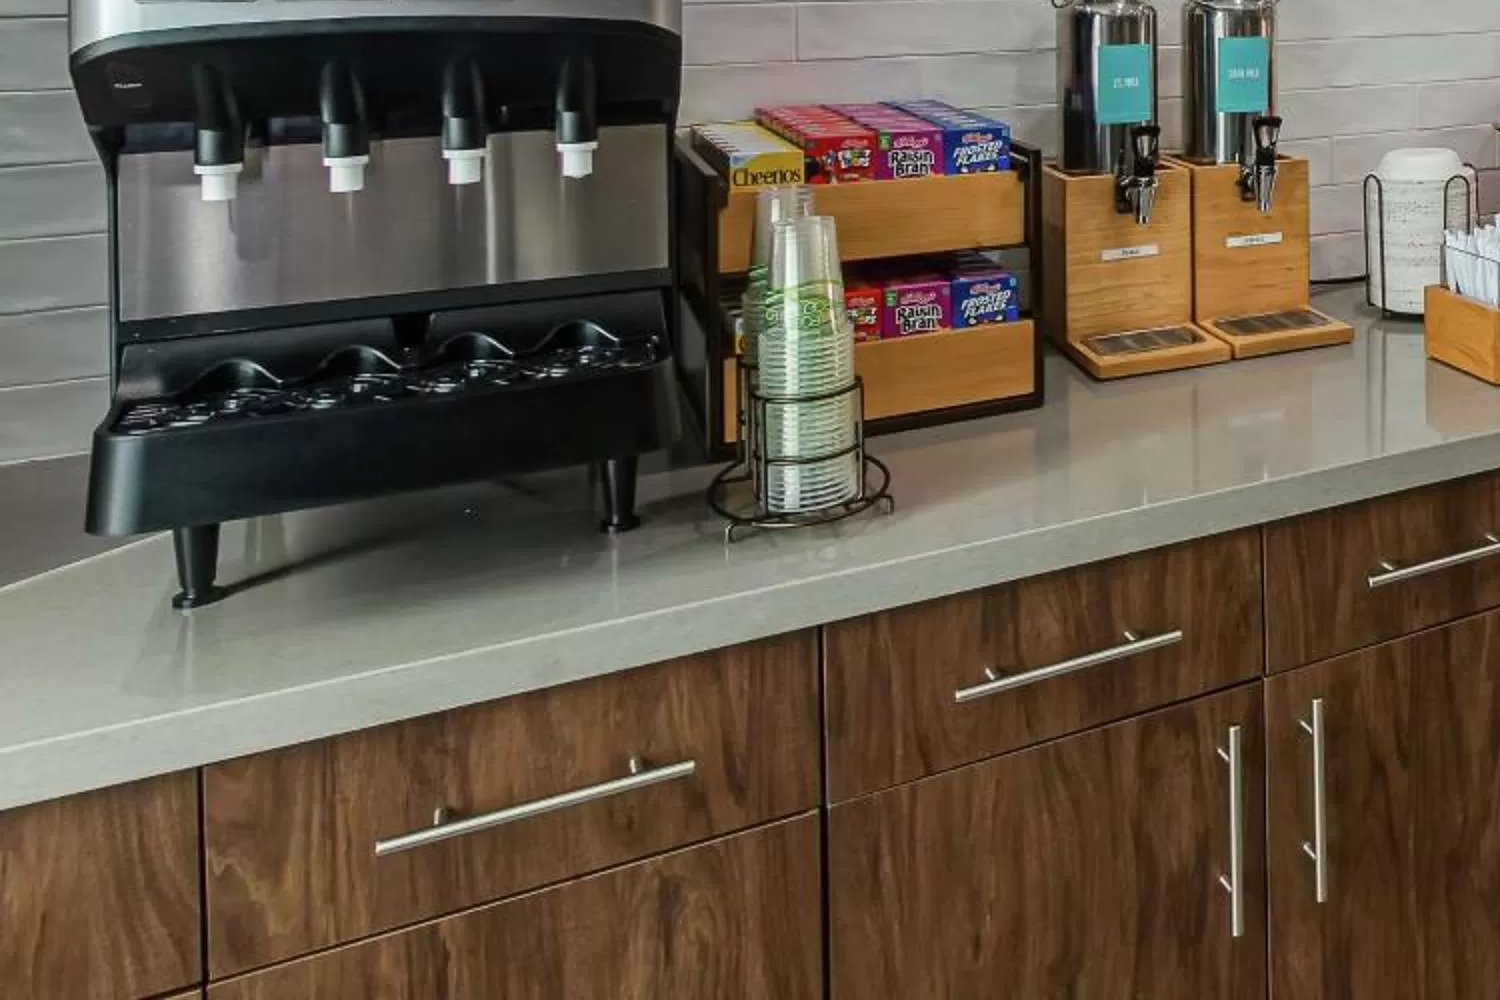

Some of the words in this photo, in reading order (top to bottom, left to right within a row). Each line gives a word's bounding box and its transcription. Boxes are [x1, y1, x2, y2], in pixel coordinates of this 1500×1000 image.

[889, 150, 934, 165] Raisin
[953, 139, 1003, 158] FROSTED
[733, 167, 801, 187] Cheerios
[894, 161, 932, 178] Bran
[961, 289, 1011, 311] FROSTED
[895, 304, 943, 322] Raisin
[964, 302, 1007, 319] FLAKES
[901, 316, 937, 335] Bran
